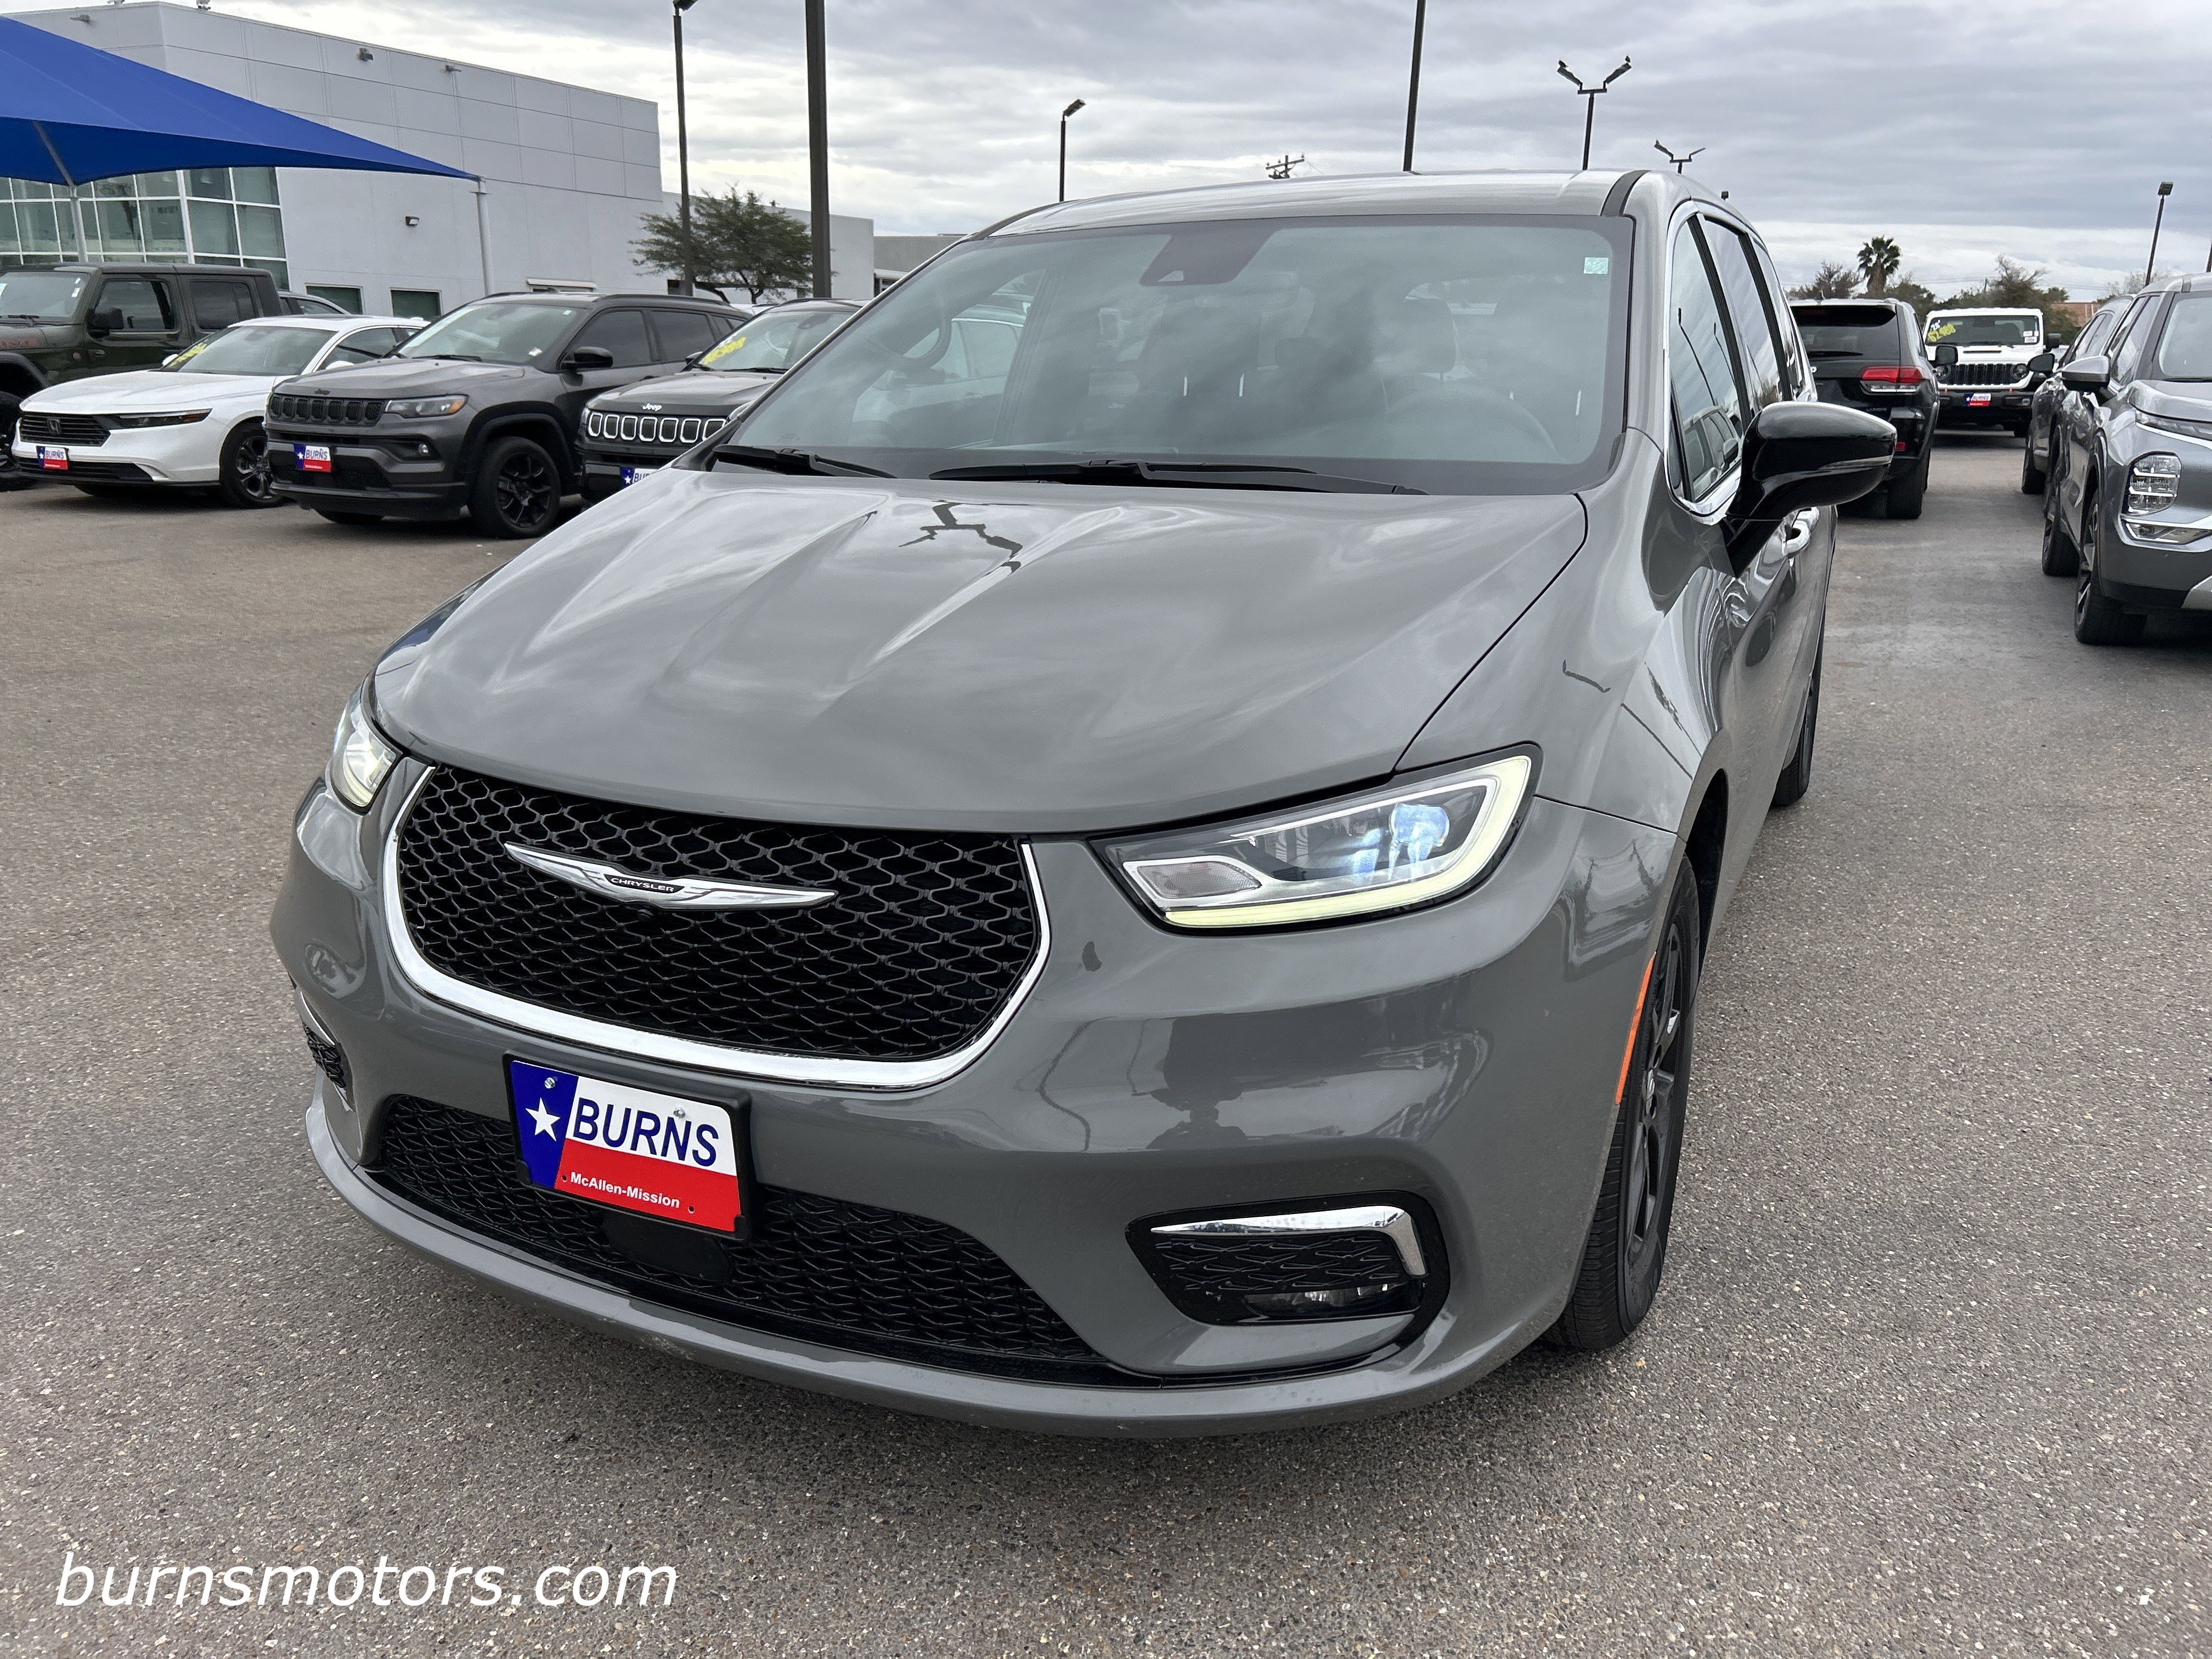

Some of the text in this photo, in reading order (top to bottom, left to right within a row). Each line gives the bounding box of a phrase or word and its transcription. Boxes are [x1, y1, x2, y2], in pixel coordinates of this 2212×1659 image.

[642, 403, 662, 411] Jeep
[45, 450, 64, 459] BURNS
[306, 450, 328, 460] BURNS
[611, 877, 674, 892] CHRYSLER
[573, 1097, 719, 1167] BURNS
[570, 1171, 680, 1209] McAllen-Mission
